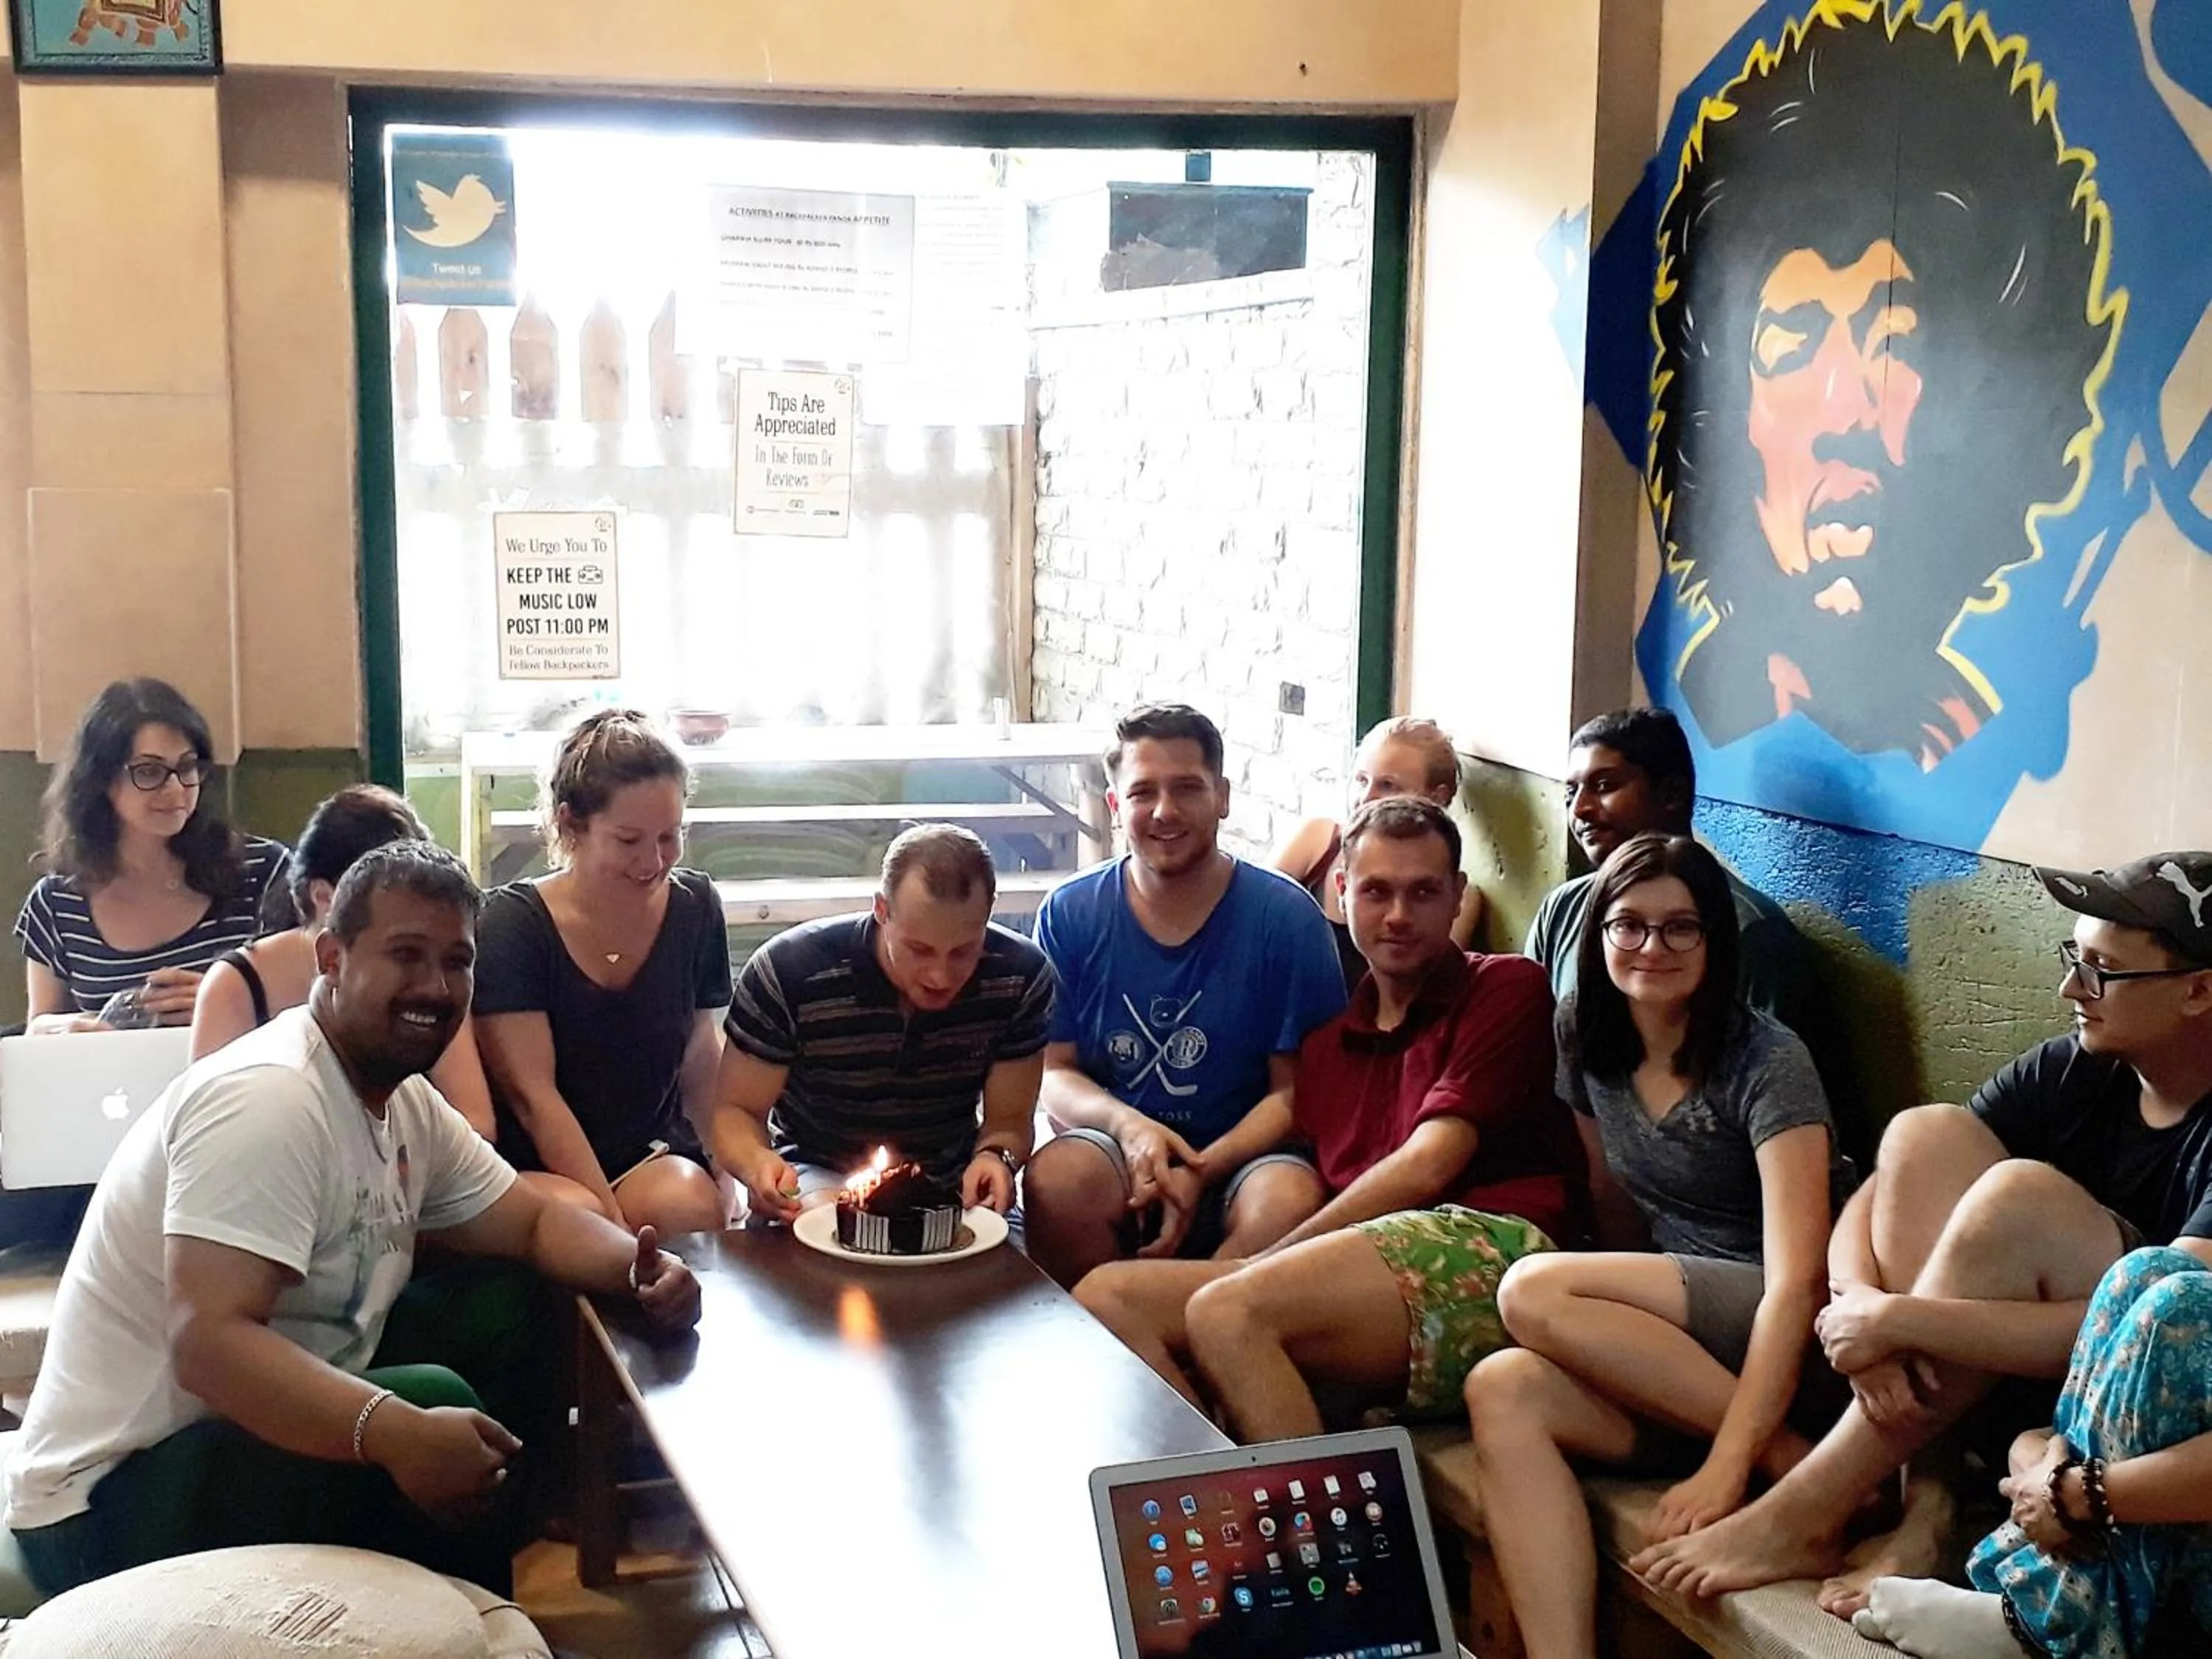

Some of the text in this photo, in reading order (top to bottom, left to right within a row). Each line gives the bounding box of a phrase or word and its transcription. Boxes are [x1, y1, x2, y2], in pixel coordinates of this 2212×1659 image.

[728, 207, 773, 218] ACTIVITIES
[431, 262, 482, 275] Tweet us
[768, 392, 825, 415] Tips Are
[754, 414, 836, 437] Appreciated
[755, 444, 766, 463] In
[771, 445, 789, 464] The
[792, 445, 818, 465] Form
[766, 468, 809, 487] Reviews
[506, 538, 608, 554] We Urge You To
[507, 567, 572, 584] KEEP THE
[519, 594, 597, 610] MUSIC LOW
[507, 618, 608, 635] POST 11:00 PM
[509, 644, 608, 656] Be Considerate To
[509, 660, 609, 672] Fellow Backpackers
